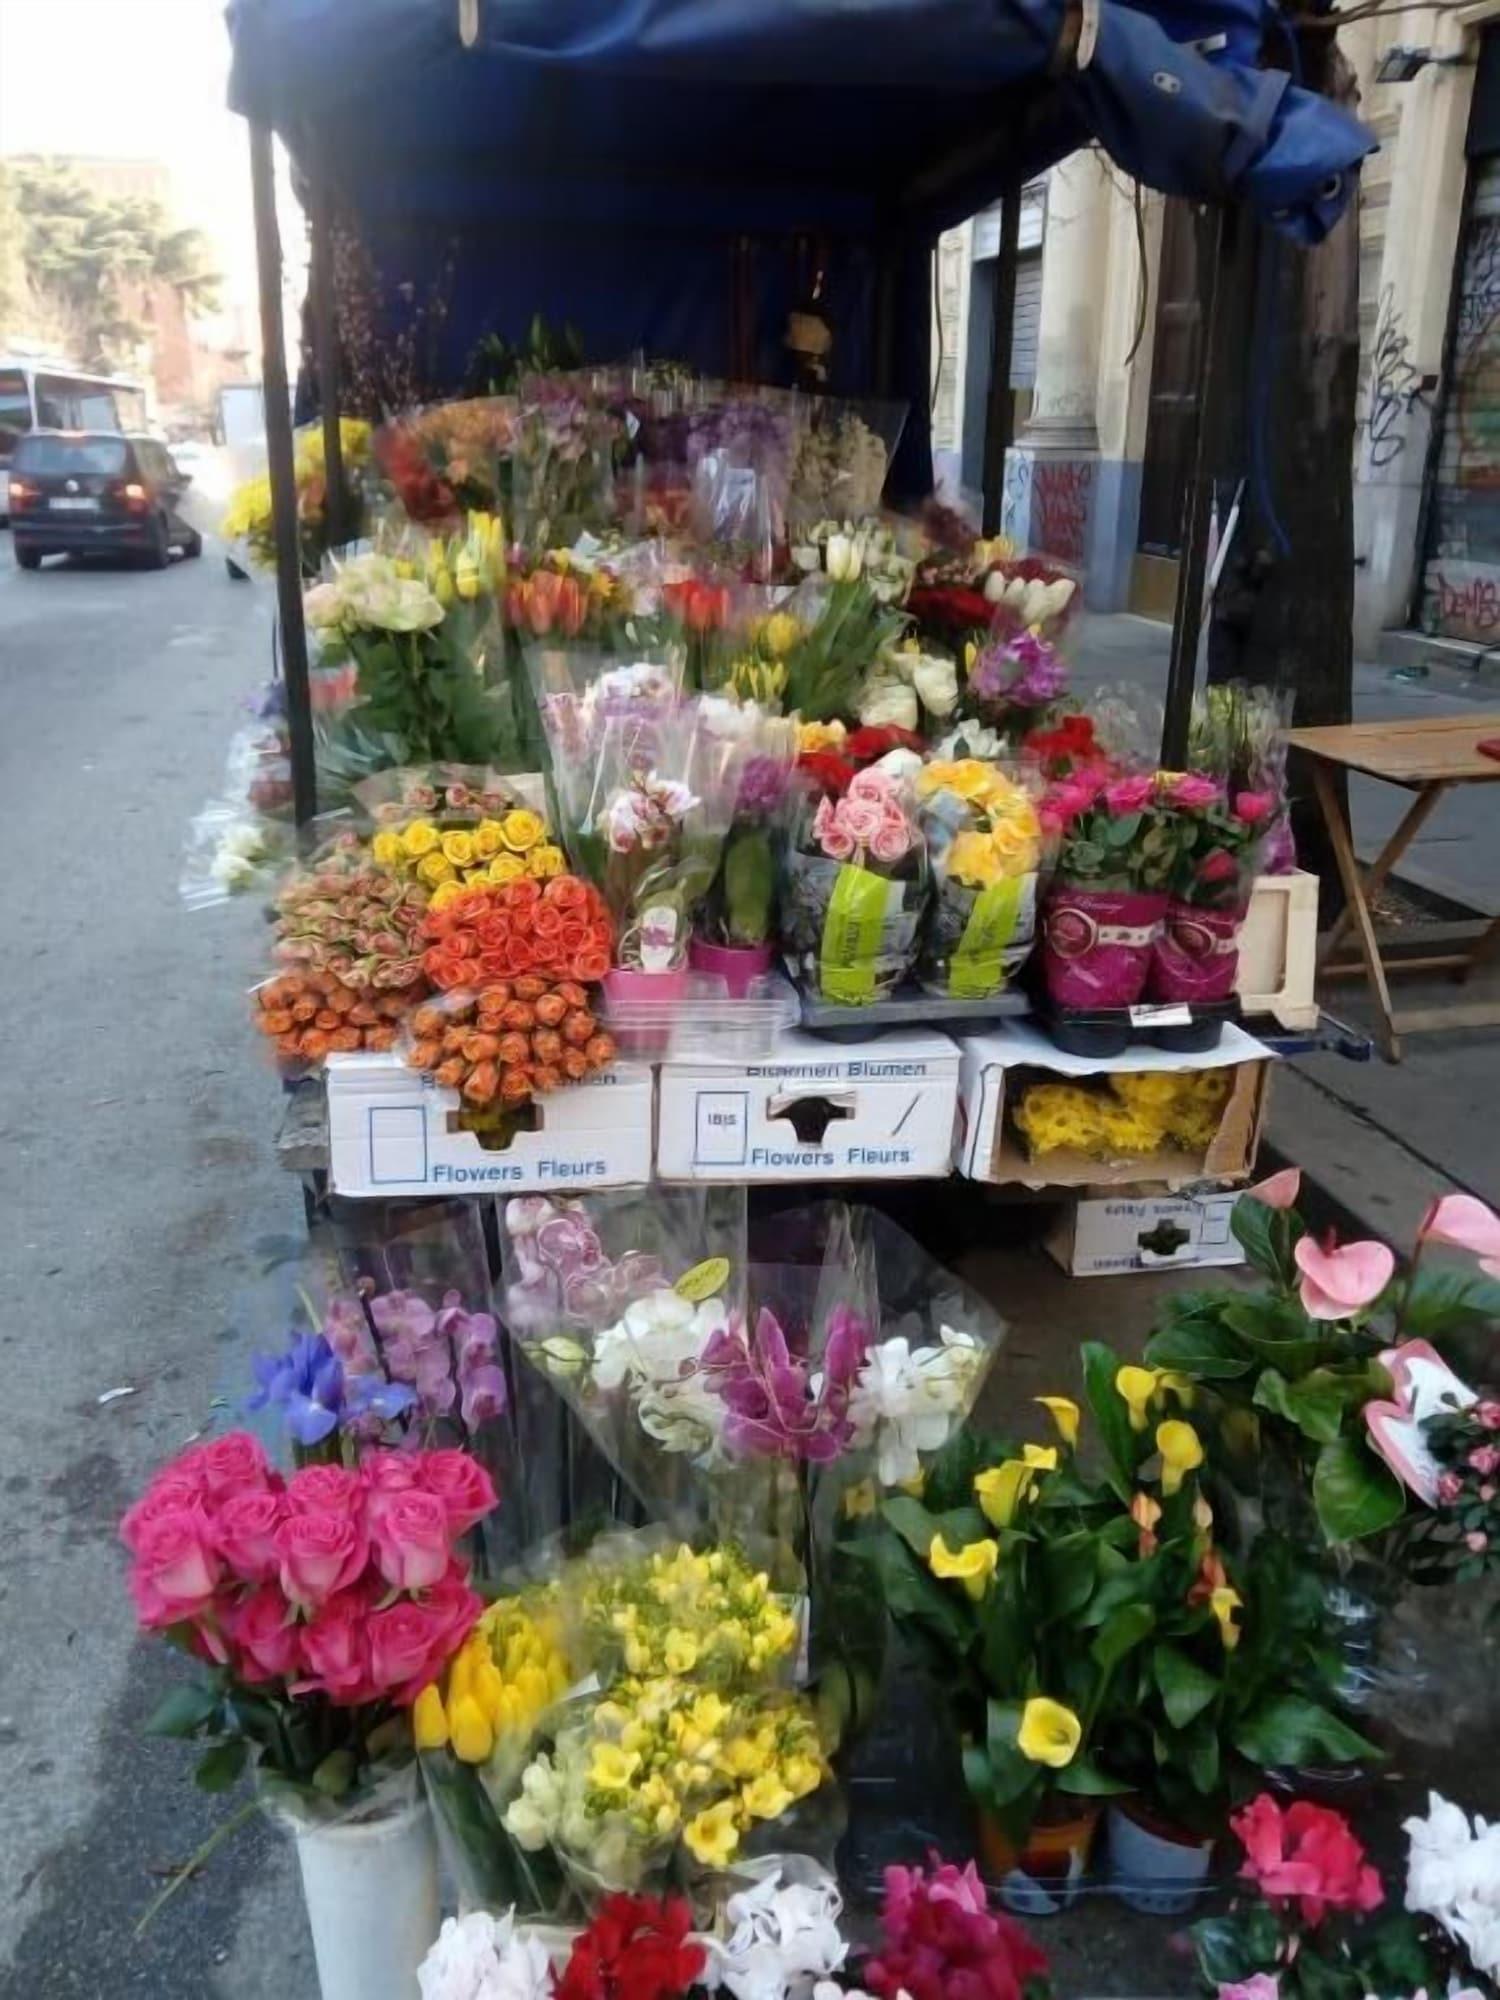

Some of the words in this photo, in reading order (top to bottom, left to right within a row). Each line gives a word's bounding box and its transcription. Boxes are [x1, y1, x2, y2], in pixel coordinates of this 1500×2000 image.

[848, 1062, 927, 1077] Blumen
[752, 1148, 835, 1167] Flowers
[847, 1148, 911, 1164] Fleurs
[433, 1164, 522, 1184] Flowers
[538, 1159, 607, 1179] Fleurs
